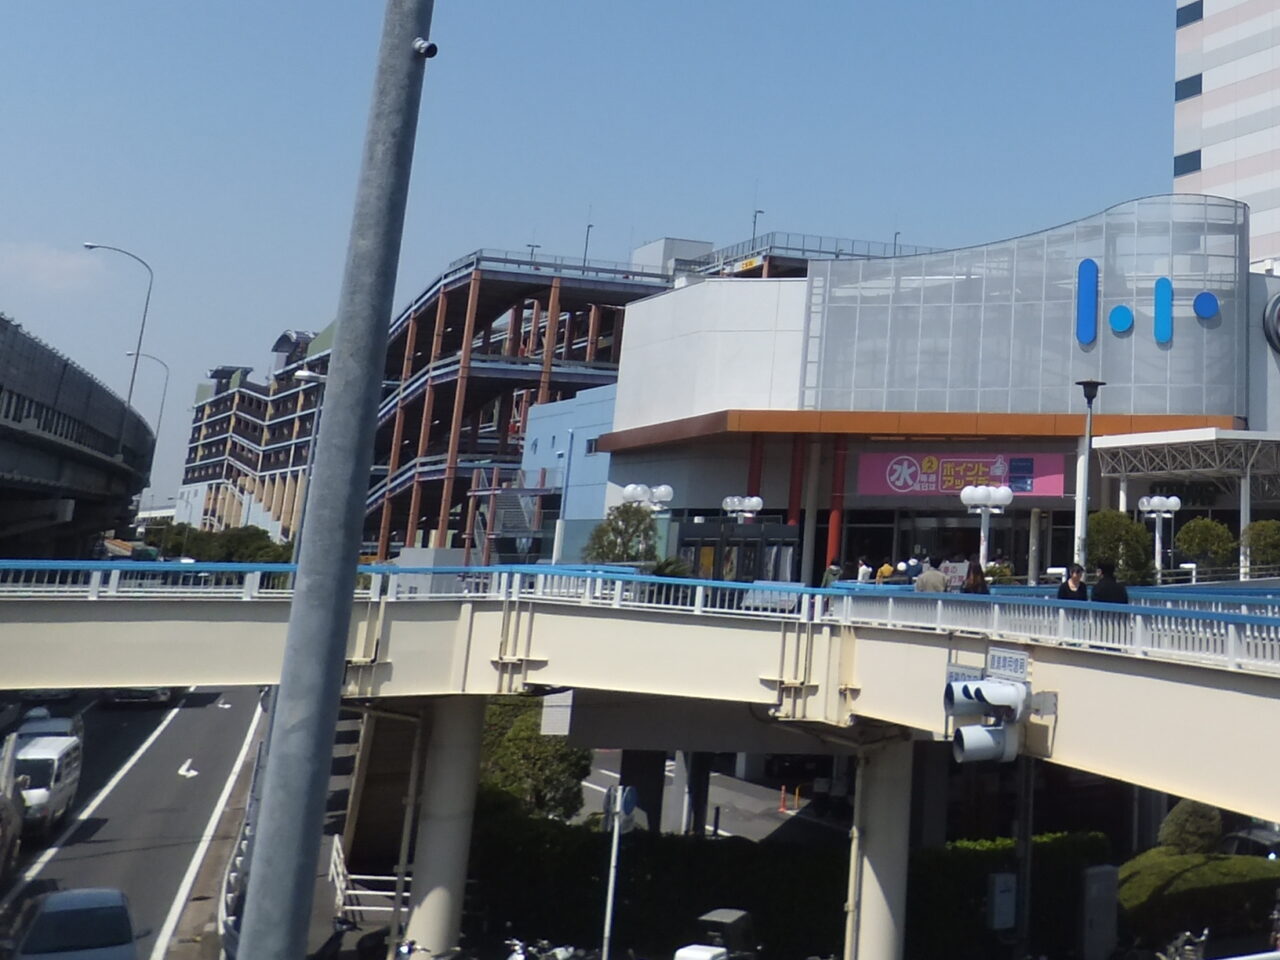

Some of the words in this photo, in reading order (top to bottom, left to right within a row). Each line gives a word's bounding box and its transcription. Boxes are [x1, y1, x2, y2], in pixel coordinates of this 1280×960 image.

[890, 460, 916, 486] 水
[943, 462, 989, 476] ポイント
